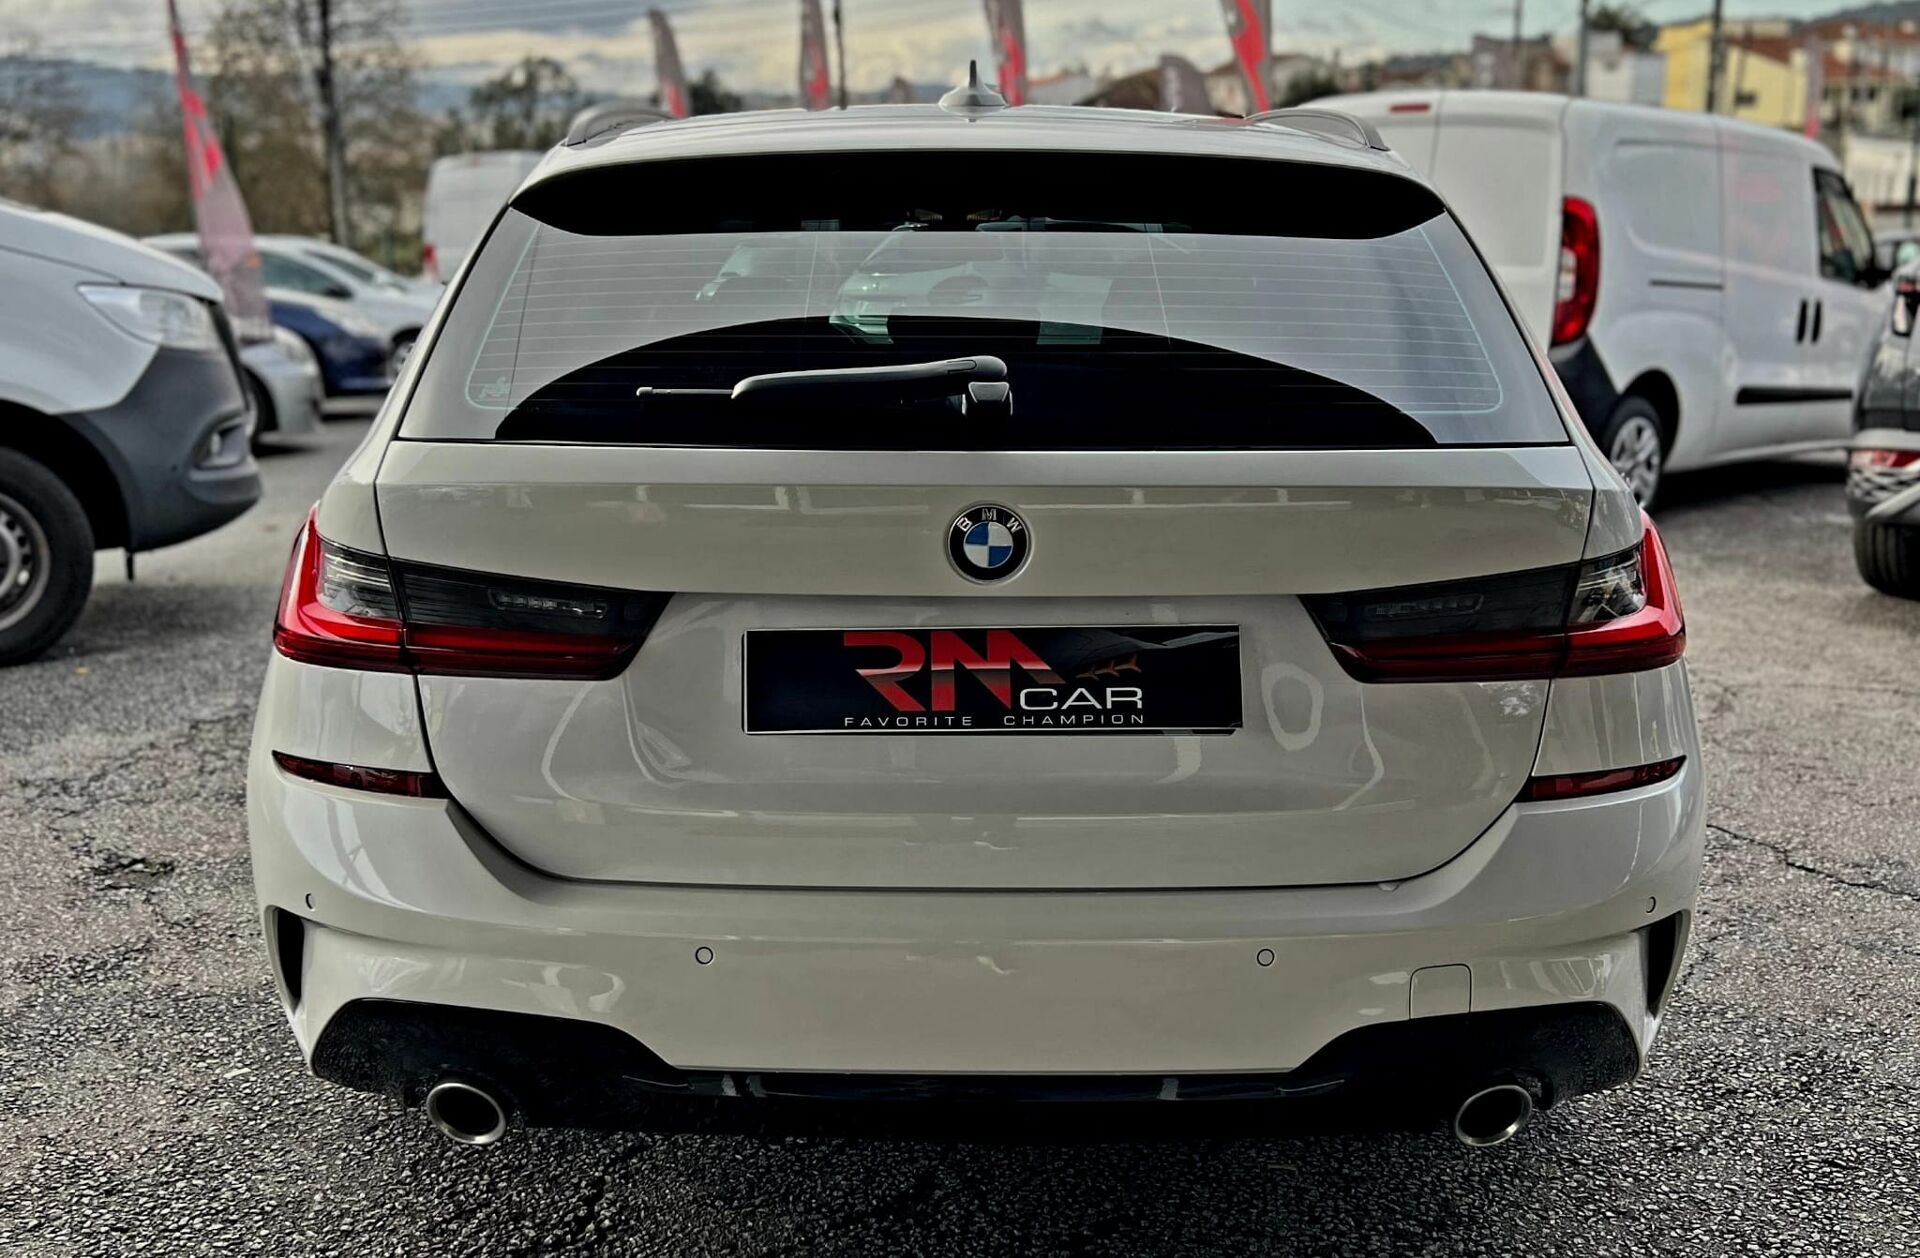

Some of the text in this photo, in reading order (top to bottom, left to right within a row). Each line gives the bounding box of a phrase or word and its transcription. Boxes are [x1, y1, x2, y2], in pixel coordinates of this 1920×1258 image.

[956, 508, 1022, 533] BMW
[843, 629, 1143, 712] RM CAR
[844, 714, 1144, 727] FAVORITE CHAMPION
